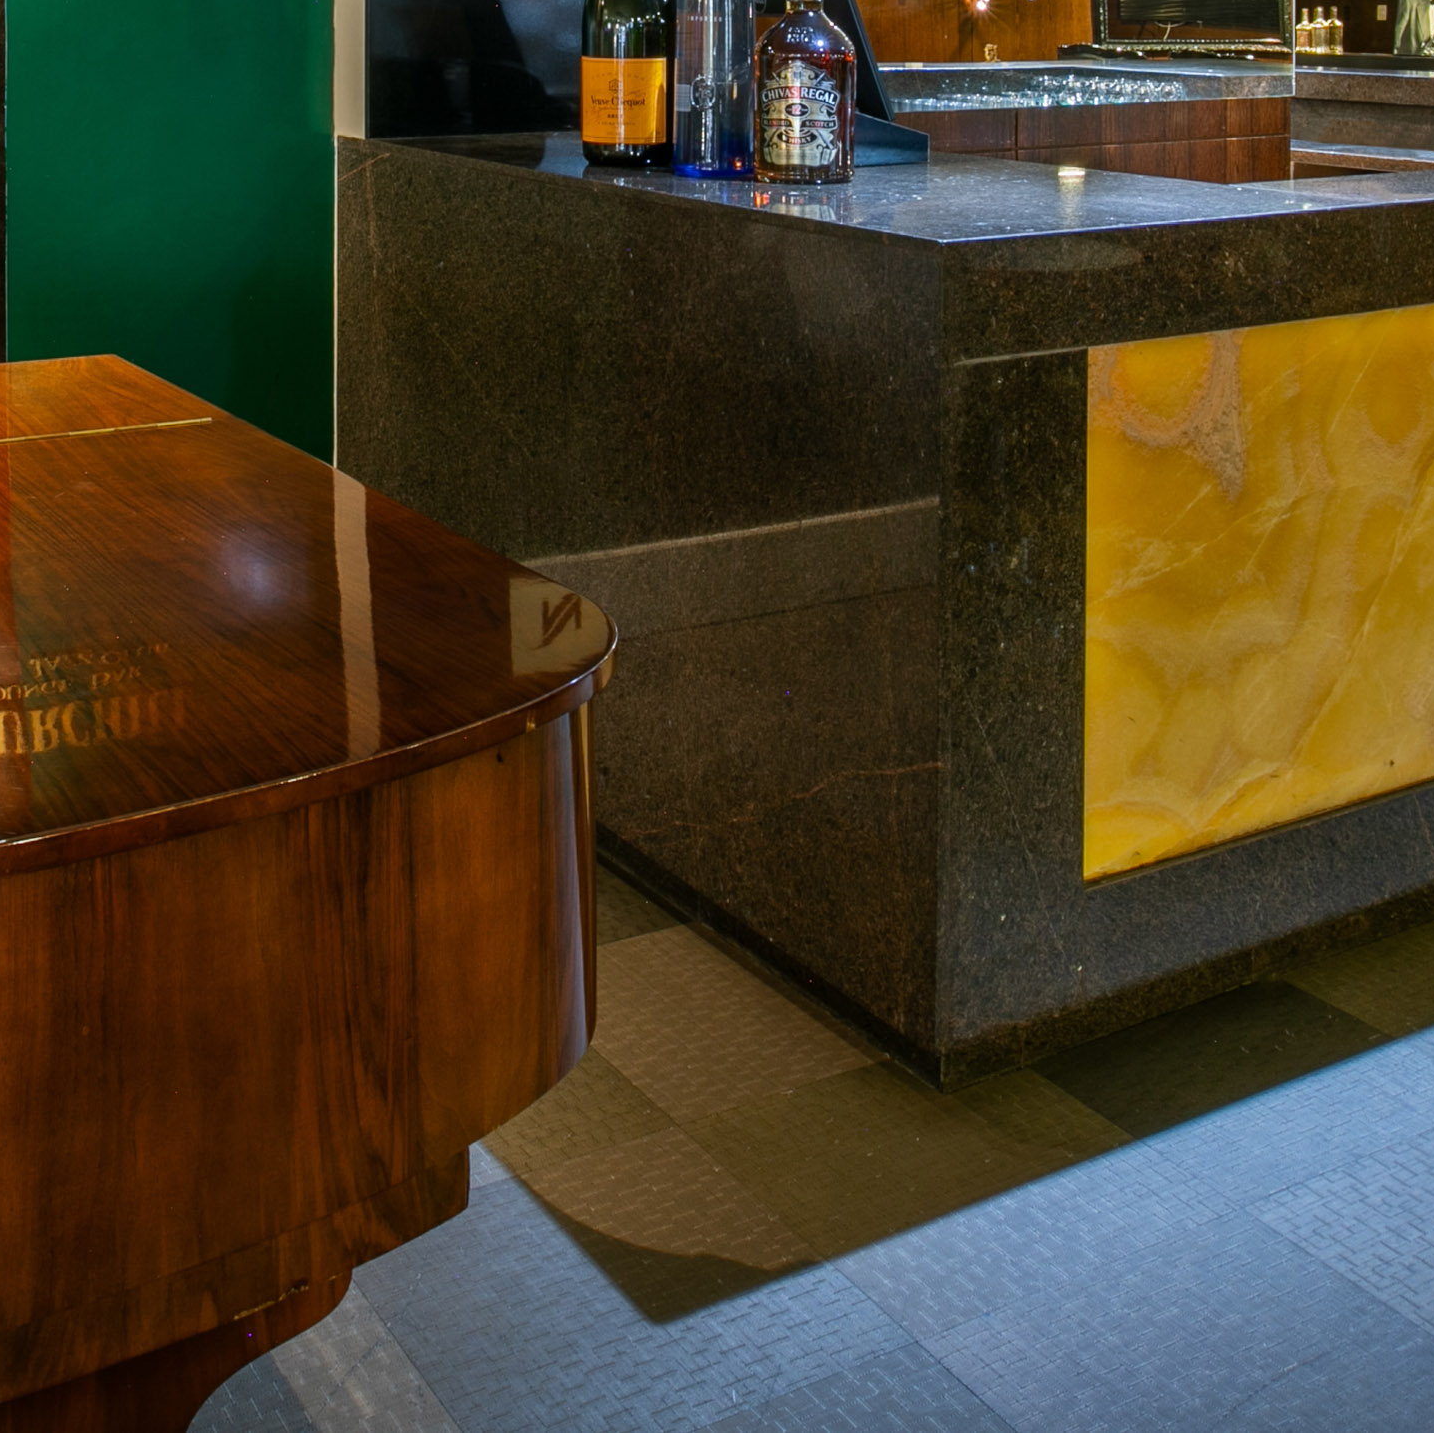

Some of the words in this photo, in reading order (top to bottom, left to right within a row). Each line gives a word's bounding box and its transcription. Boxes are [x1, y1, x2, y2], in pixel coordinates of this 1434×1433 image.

[762, 87, 798, 103] CHIVAS
[800, 87, 836, 105] REGAL
[805, 120, 834, 128] SCOTCH
[782, 134, 812, 145] WHISKY
